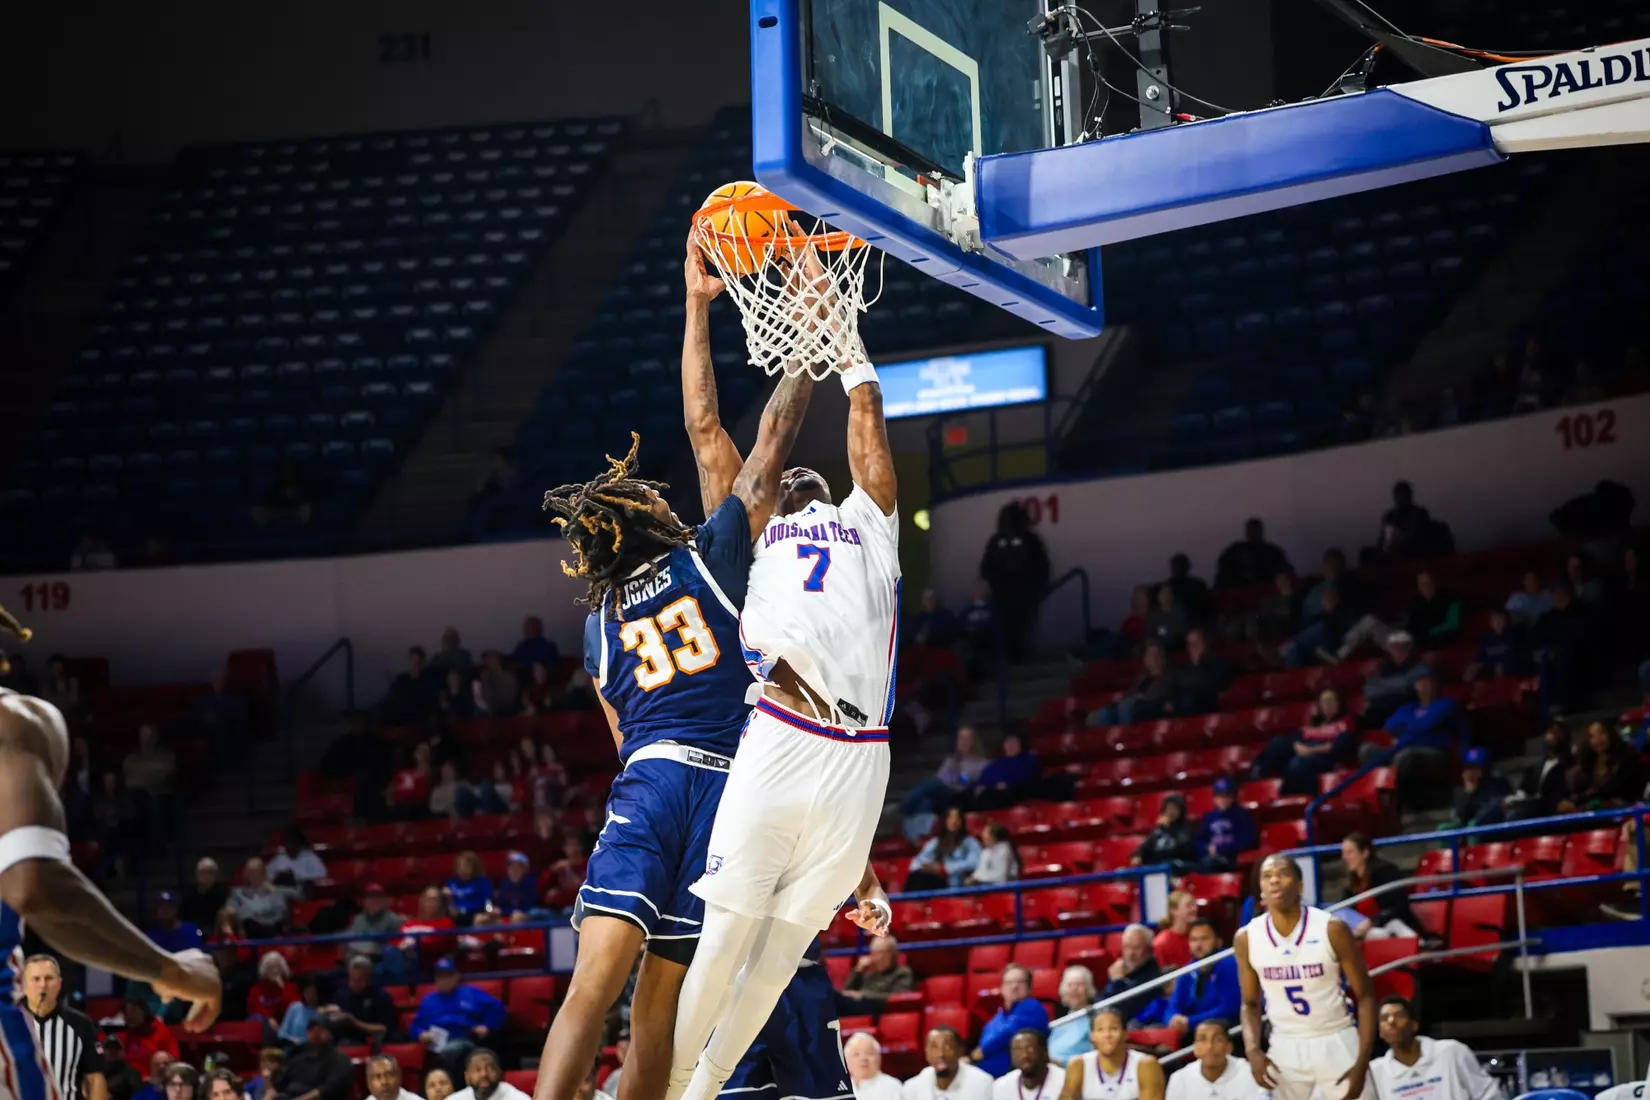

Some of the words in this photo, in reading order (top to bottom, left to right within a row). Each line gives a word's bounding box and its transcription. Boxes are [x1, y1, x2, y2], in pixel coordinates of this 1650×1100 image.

[379, 33, 431, 63] 231
[1496, 48, 1650, 113] SPALDI
[1556, 409, 1617, 449] 102
[1014, 494, 1059, 525] 01
[829, 521, 862, 546] TECH
[797, 544, 832, 592] 7
[20, 582, 69, 612] 119
[622, 565, 673, 610] JONES
[618, 595, 721, 693] 33
[1285, 985, 1311, 1016] 5
